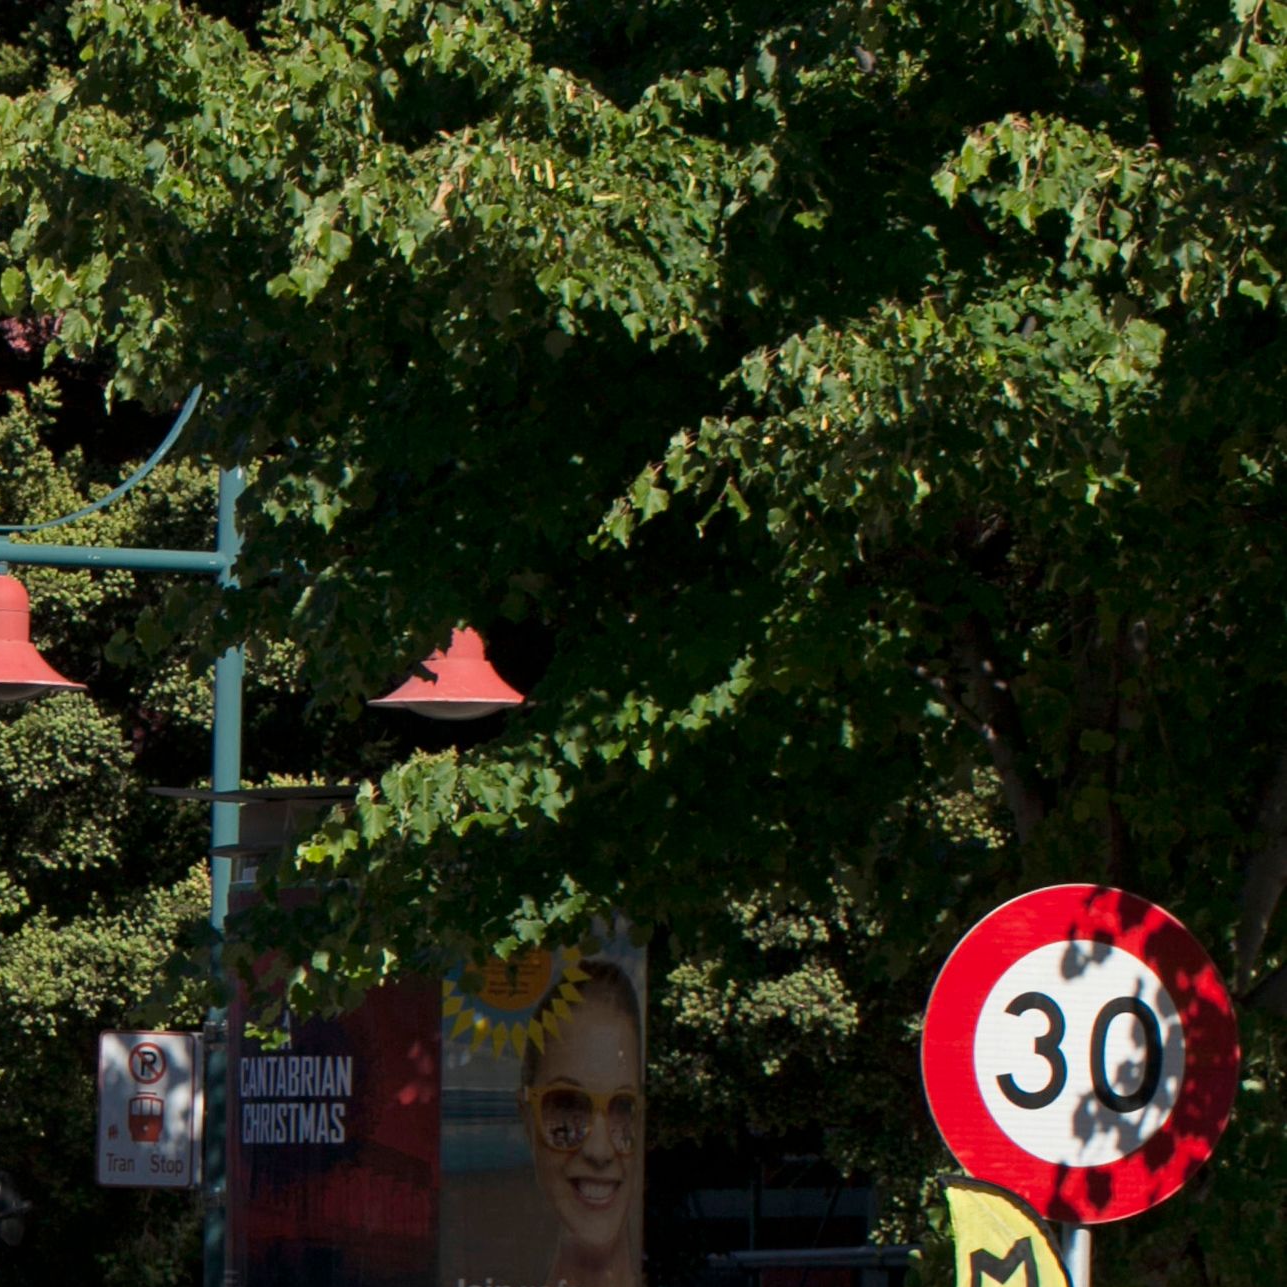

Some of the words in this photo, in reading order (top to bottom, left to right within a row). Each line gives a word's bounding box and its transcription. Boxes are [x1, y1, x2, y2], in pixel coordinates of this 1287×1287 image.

[996, 991, 1163, 1114] 30
[240, 1056, 352, 1097] CANTABRIAN
[242, 1102, 346, 1144] CHRISTMAS
[151, 1154, 184, 1177] Stop
